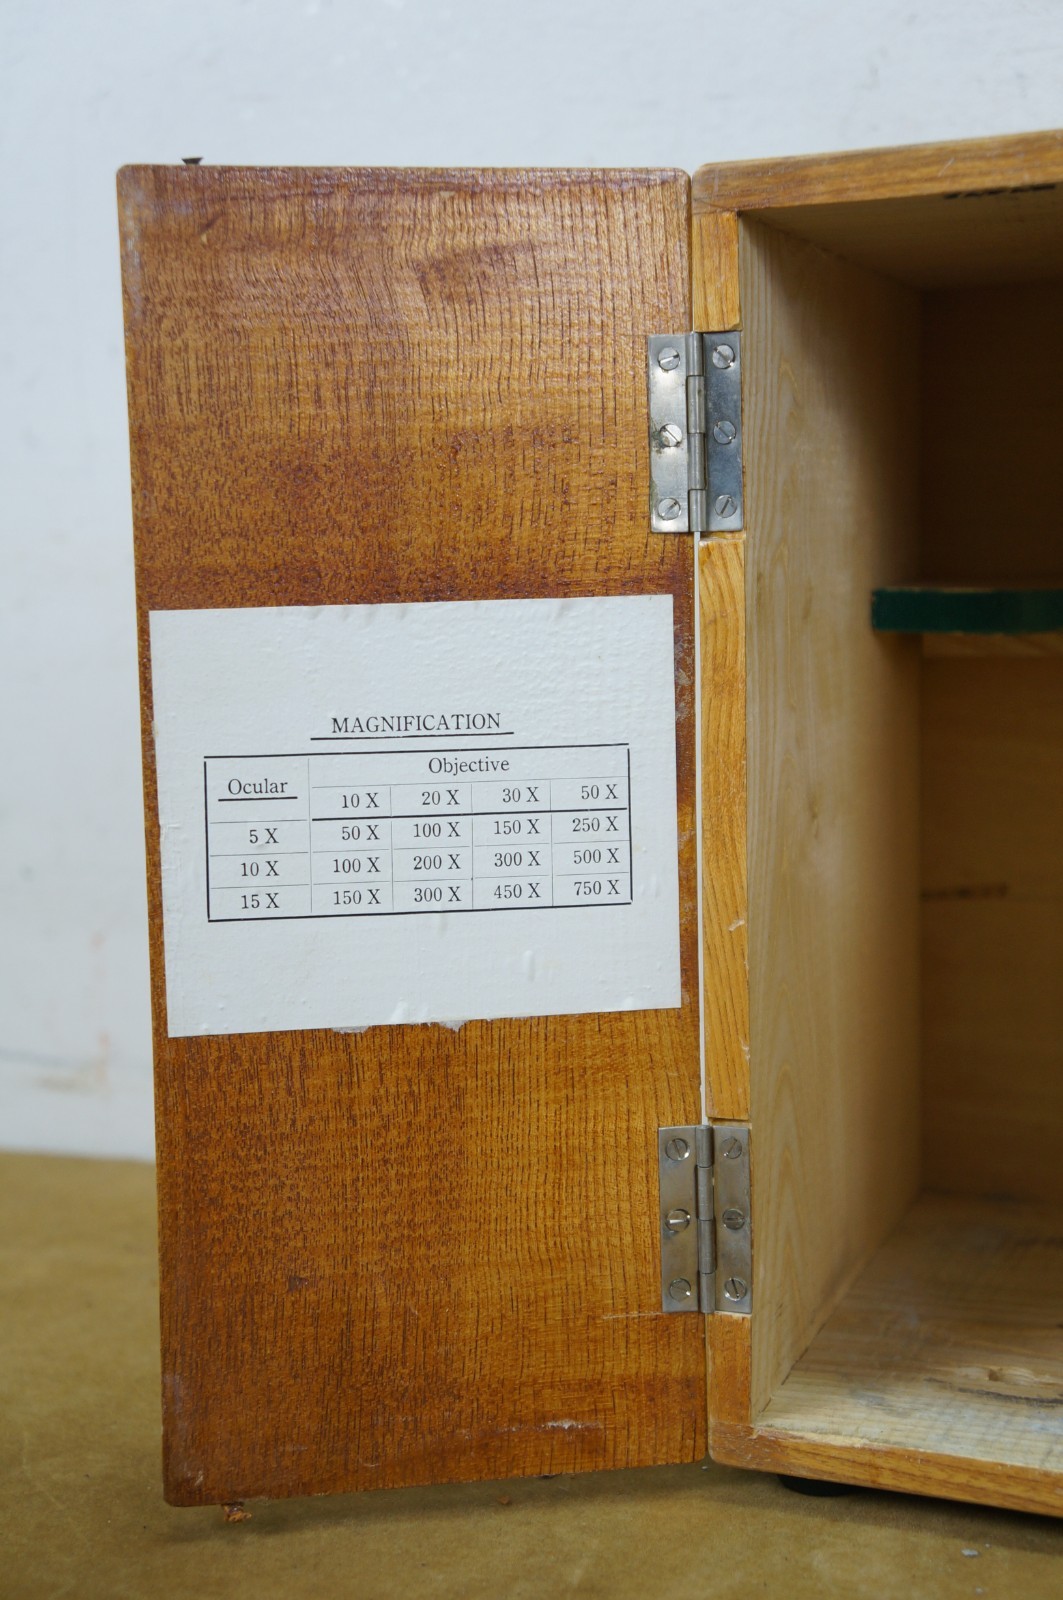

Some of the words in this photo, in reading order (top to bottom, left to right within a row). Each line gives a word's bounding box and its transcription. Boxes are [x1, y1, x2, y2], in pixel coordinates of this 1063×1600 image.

[331, 712, 501, 734] MAGNIFICATION
[428, 755, 510, 777] Objective
[227, 777, 289, 796] Ocular
[341, 793, 360, 809] 10
[365, 792, 380, 809] X
[421, 790, 441, 806] 20
[445, 789, 461, 806] X
[502, 787, 521, 804] 30
[525, 786, 540, 803] X
[581, 784, 600, 800] 50
[604, 783, 619, 800] X
[249, 829, 259, 845] 5
[264, 827, 280, 845] X
[341, 825, 361, 841] 50
[365, 824, 381, 841] X
[413, 822, 442, 838] 100
[446, 821, 461, 838] X
[493, 819, 522, 835] 150
[526, 818, 541, 835] X
[572, 817, 601, 833] 250
[605, 815, 619, 832] X
[240, 861, 260, 877] 10
[265, 860, 280, 877] X
[332, 858, 362, 874] 100
[366, 856, 382, 873] X
[413, 854, 443, 871] 200
[447, 853, 462, 870] X
[494, 851, 523, 868] 300
[527, 850, 541, 867] X
[573, 848, 602, 865] 500
[606, 847, 620, 864] X
[240, 893, 261, 910] 15
[265, 892, 280, 909] X
[333, 889, 362, 906] 150
[367, 888, 382, 905] X
[413, 886, 443, 903] 300
[447, 885, 462, 903] X
[493, 883, 523, 900] 450
[527, 882, 542, 899] X
[573, 880, 602, 897] 750
[606, 879, 621, 896] X
